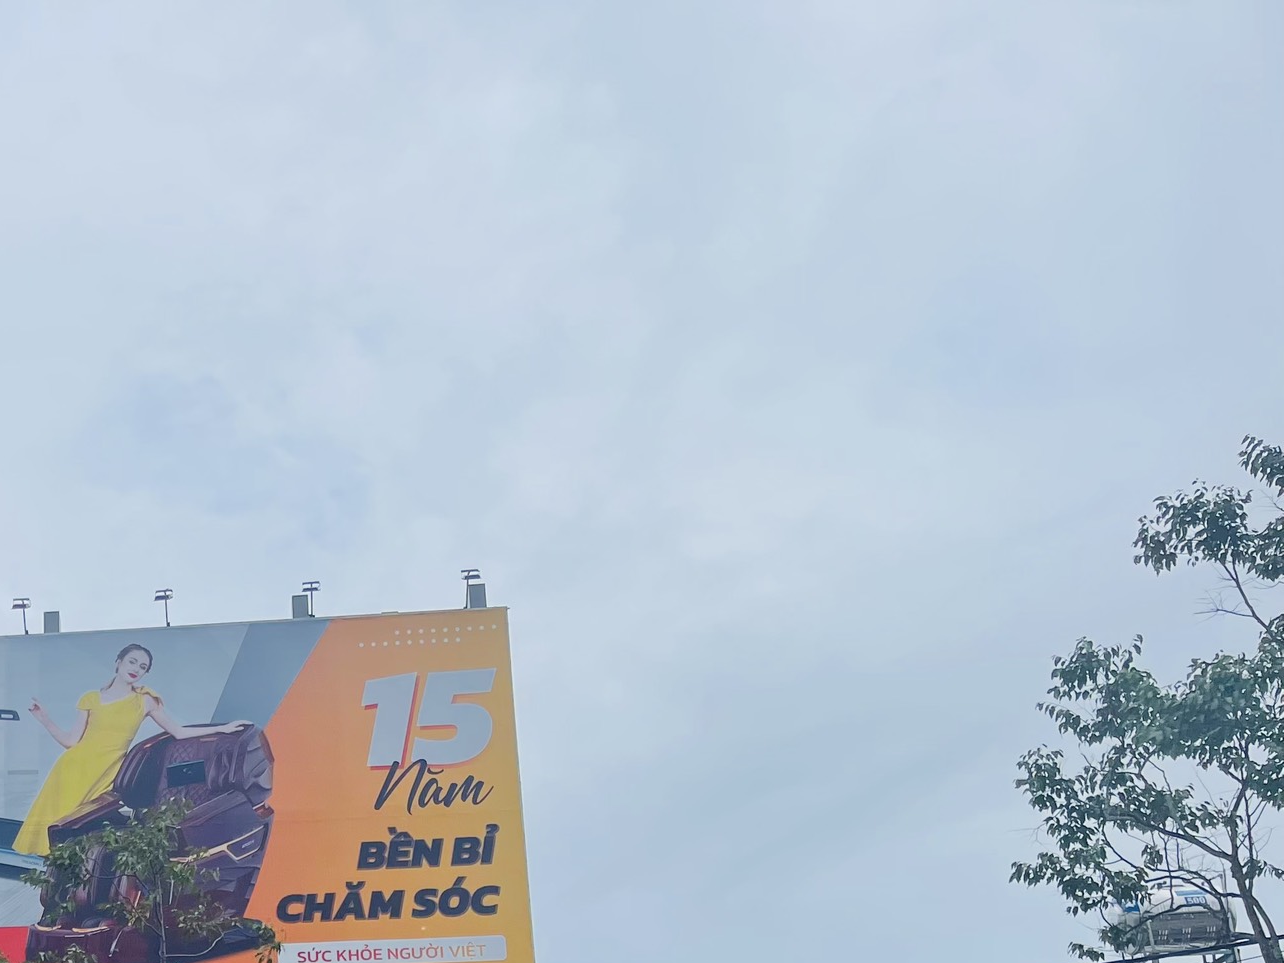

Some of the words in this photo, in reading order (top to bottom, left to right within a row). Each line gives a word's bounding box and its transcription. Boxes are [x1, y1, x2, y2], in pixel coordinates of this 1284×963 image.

[361, 668, 497, 770] 15
[374, 759, 494, 815] Năm
[357, 827, 444, 870] BỀN
[451, 824, 500, 866] BỈ
[276, 881, 405, 923] CHĂM
[412, 876, 501, 919] SÓC
[297, 947, 331, 963] SỨC
[336, 944, 382, 962] KHỎE
[387, 943, 444, 960] NGƯỜI
[449, 942, 486, 959] VIỆT
